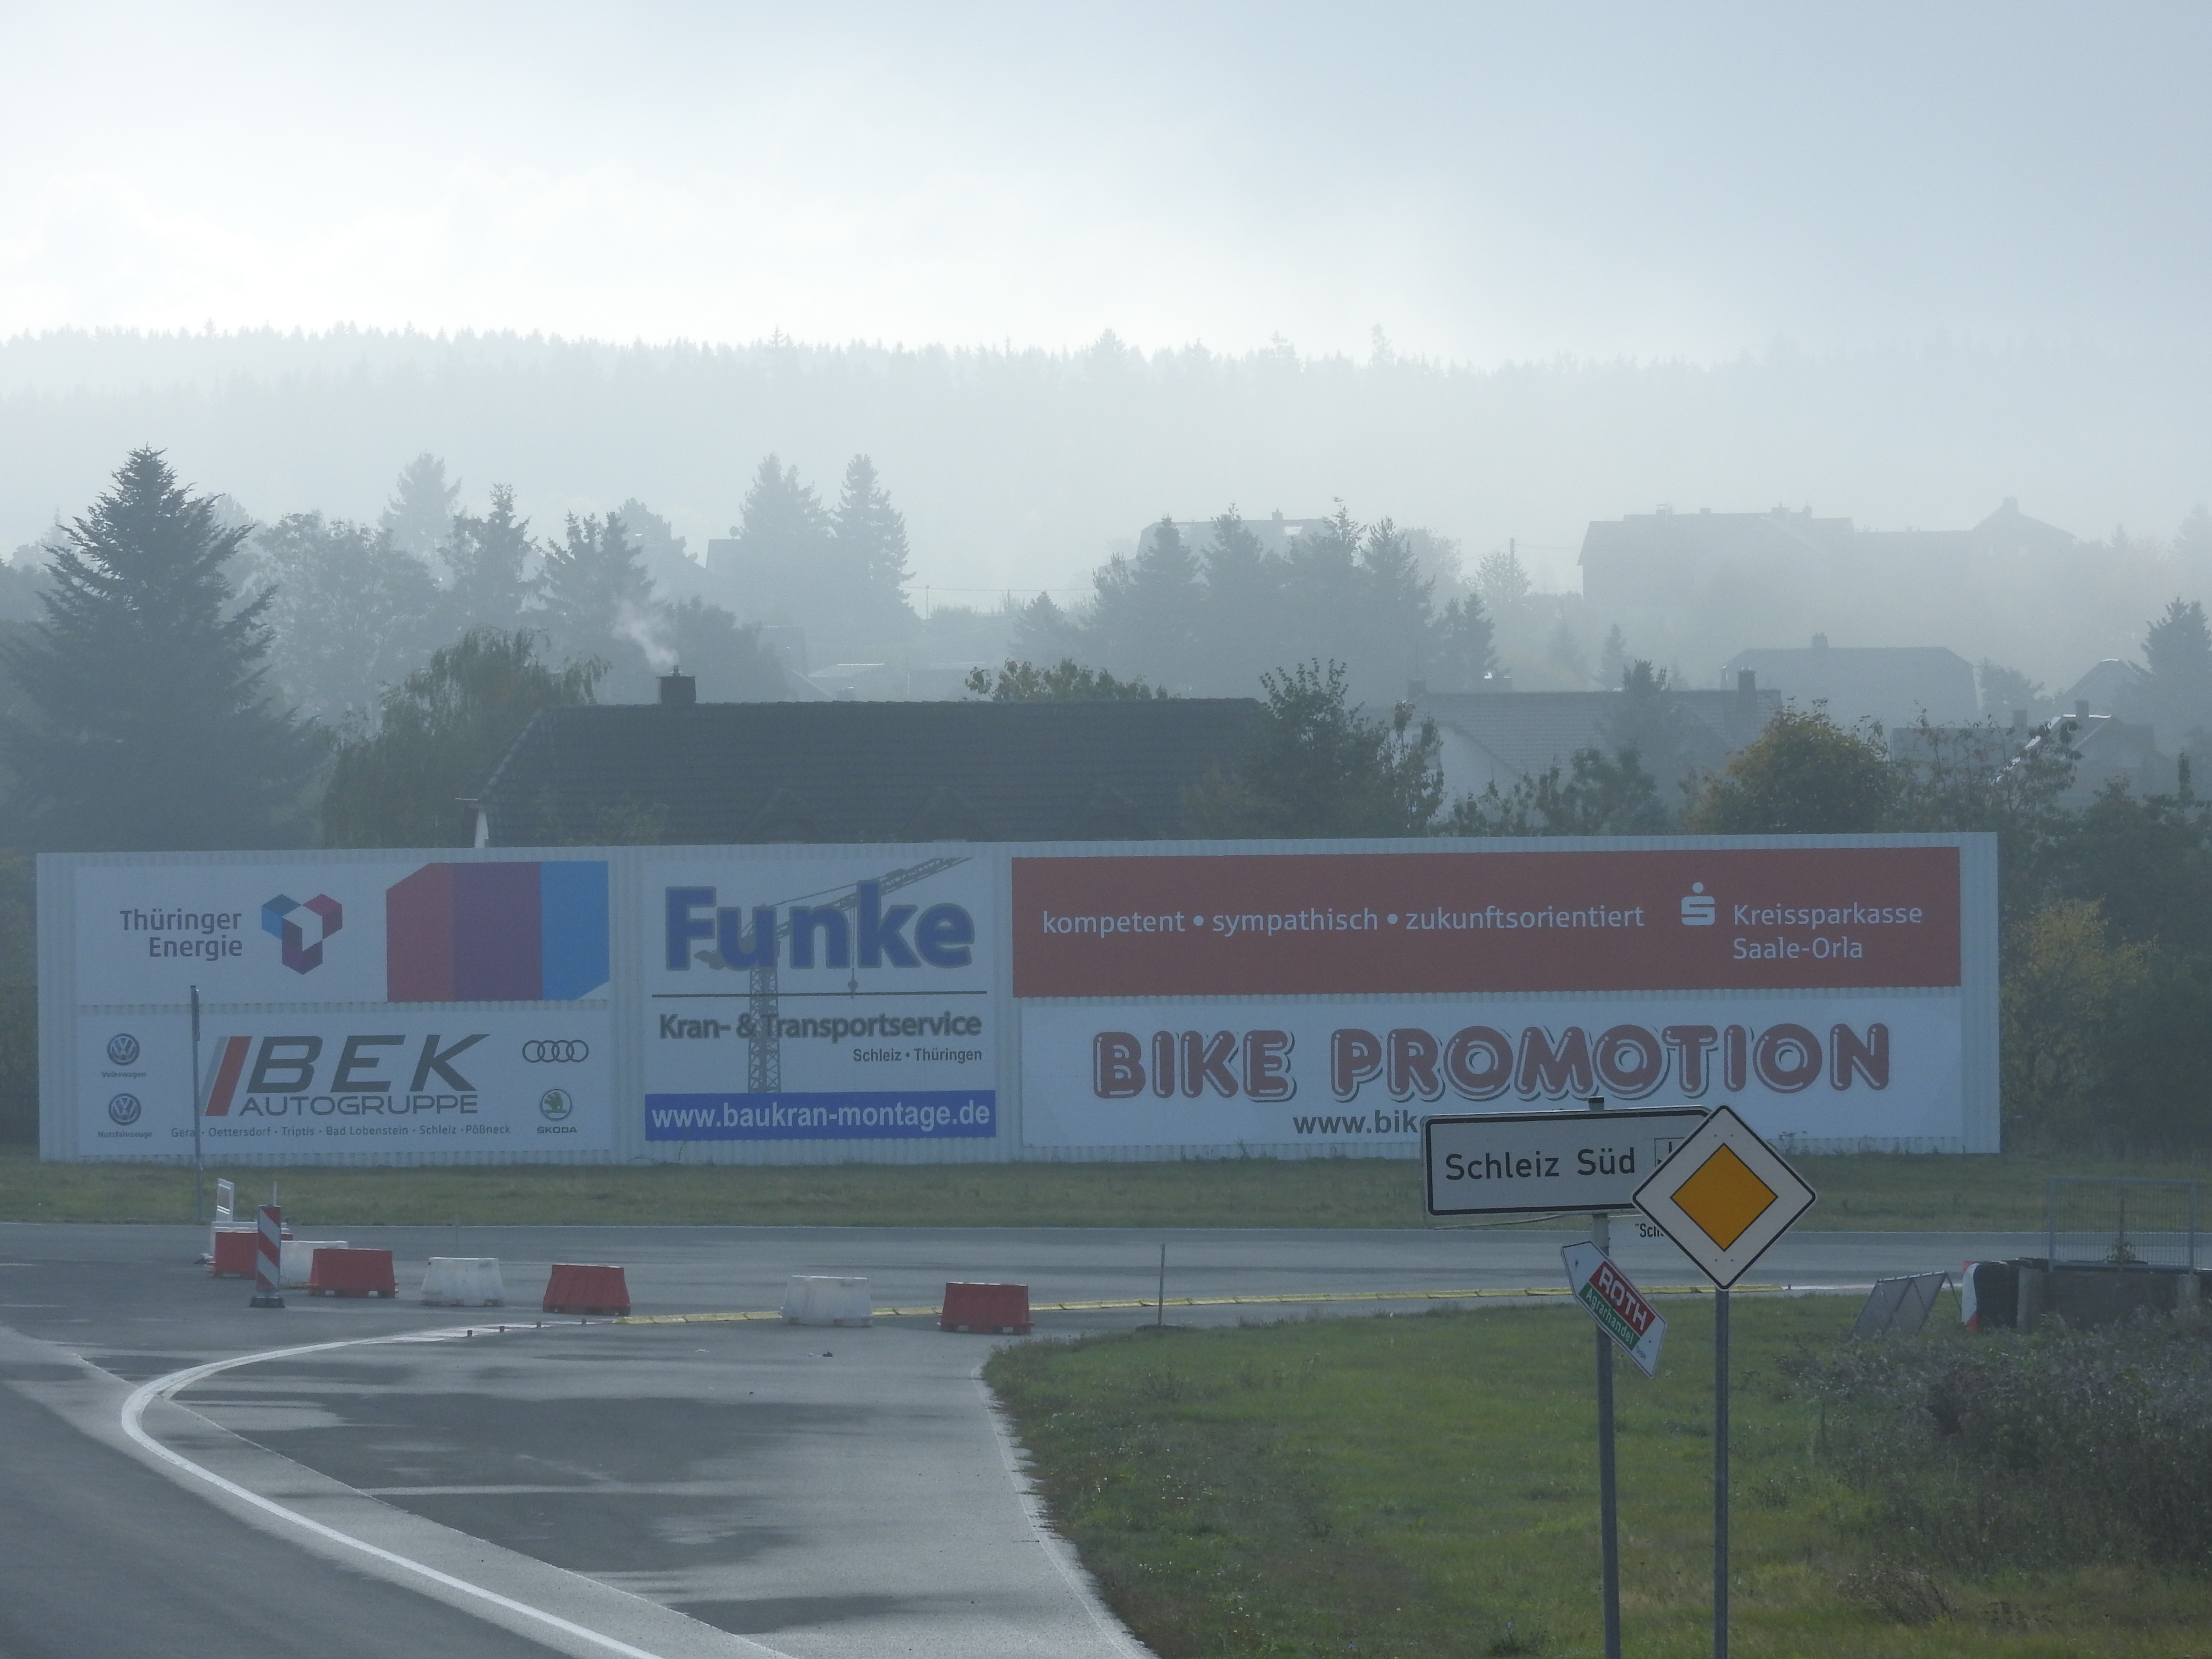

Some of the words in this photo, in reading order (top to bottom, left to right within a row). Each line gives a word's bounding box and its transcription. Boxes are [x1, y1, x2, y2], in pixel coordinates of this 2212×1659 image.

[120, 908, 242, 934] Thüringer
[665, 878, 975, 971] Funke
[1043, 911, 1186, 938] kompetent
[1212, 907, 1378, 937] sympathisch
[1406, 905, 1644, 930] zukunftsorientiert
[1733, 902, 1923, 929] Kreissparkasse
[149, 936, 243, 961] Energie
[1733, 936, 1863, 960] Saale-Orla
[660, 1013, 731, 1039] Kran-
[736, 1012, 757, 1039] &
[761, 1011, 982, 1044] Transportservice
[246, 1034, 490, 1094] BEK
[853, 1048, 902, 1062] Schleiz
[914, 1047, 982, 1064] Thüringen
[1093, 1030, 1297, 1103] BIKE
[1331, 1023, 1889, 1103] PROMOTION
[240, 1094, 478, 1116] AUTOGRUPPE
[651, 1100, 990, 1131] www.baukran-montage.de
[208, 1126, 271, 1138] Oettersdorf
[282, 1126, 314, 1139] Triptis
[326, 1126, 347, 1136] Bad
[349, 1125, 408, 1136] Lobenstein
[420, 1124, 457, 1135] Schleiz
[466, 1124, 511, 1134] Pößneck
[1293, 1110, 1418, 1133] www.bik
[1445, 1151, 1560, 1181] Schleiz
[1577, 1147, 1635, 1177] Süd
[1599, 1265, 1647, 1331] ROTH
[1586, 1288, 1634, 1345] Agrarhandel
